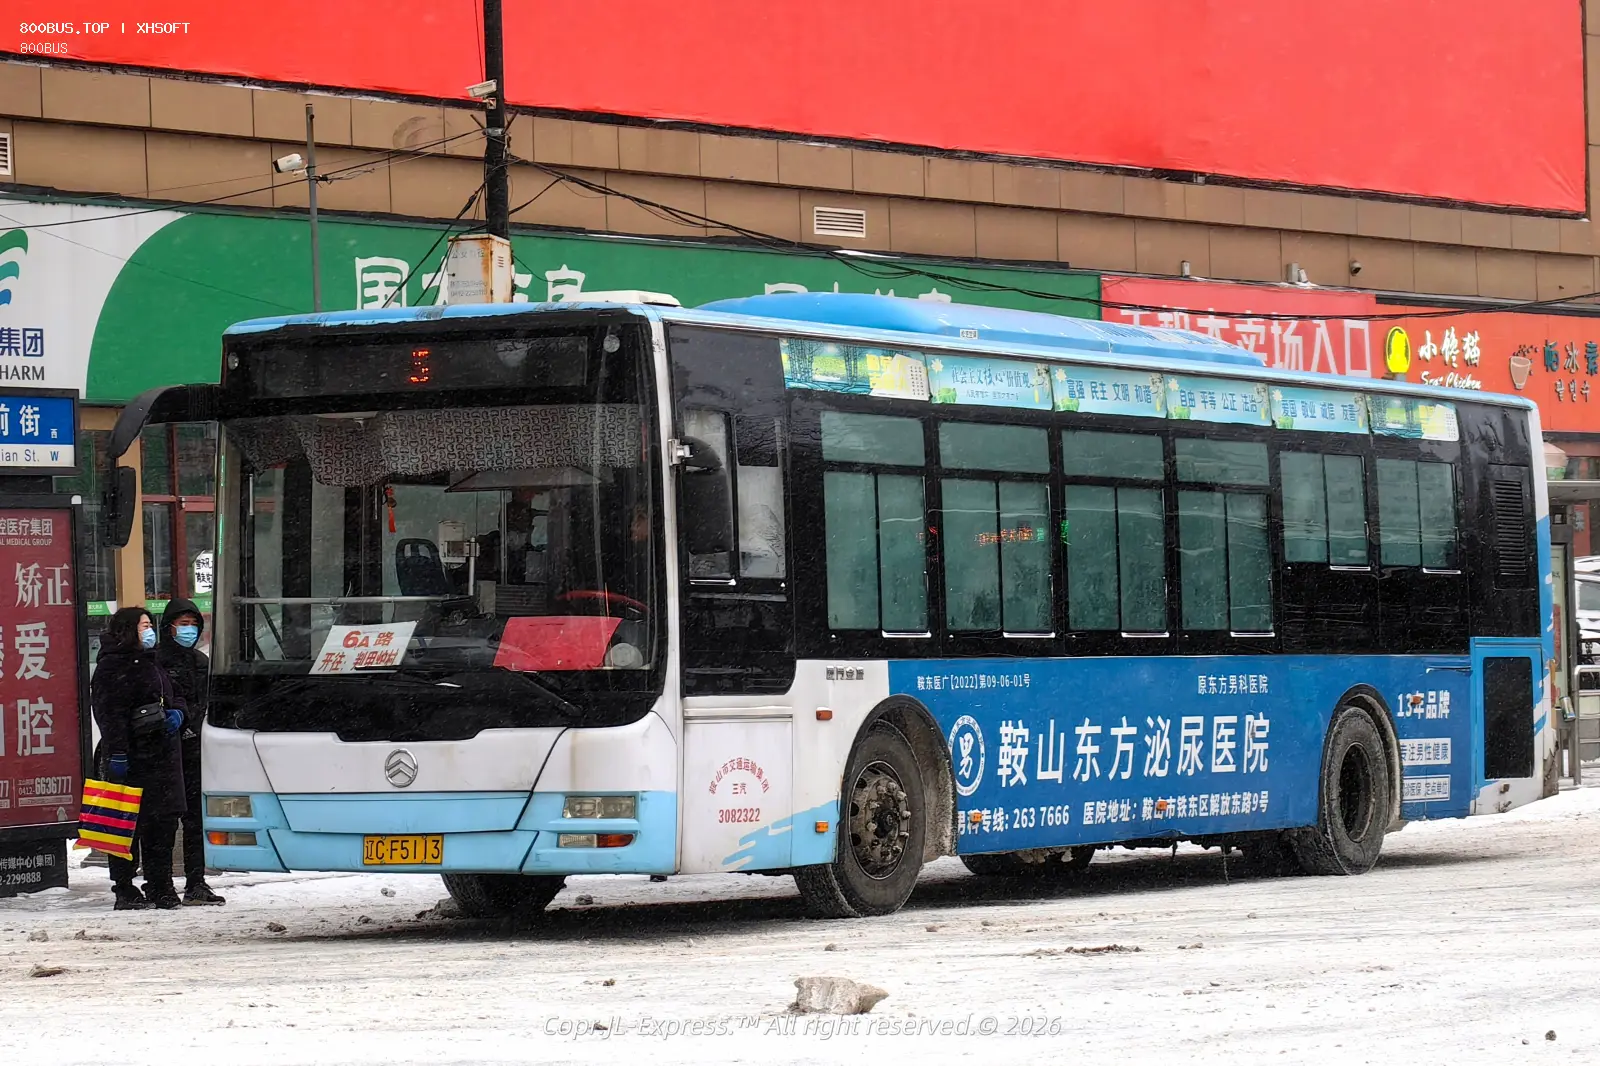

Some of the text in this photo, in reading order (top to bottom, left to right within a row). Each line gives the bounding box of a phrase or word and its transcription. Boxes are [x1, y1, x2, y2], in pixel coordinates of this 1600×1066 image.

[0, 327, 44, 358] 集团
[1066, 379, 1152, 404] 富强 民主 文明 和谐
[1179, 389, 1197, 408] 自由
[1200, 391, 1217, 410] 平等
[1221, 393, 1238, 411] 公正
[1281, 400, 1298, 418] 爱国
[24, 449, 40, 462] St.
[50, 451, 59, 461] W
[6, 537, 32, 546] MEDICAL
[32, 537, 53, 546] GROUP
[15, 562, 73, 609] 矫正
[342, 630, 370, 649] 6A
[0, 621, 51, 681] 爱
[1197, 674, 1269, 695] 原东方男科医院
[1397, 690, 1451, 720] 13年品牌
[0, 696, 55, 757] 腔
[996, 711, 1271, 788] 鞍山东方泌尿医院
[1400, 742, 1449, 761] 专注男性健康
[732, 783, 747, 795] 三汽
[718, 808, 761, 824] 3082322
[1013, 807, 1036, 829] 263
[1040, 804, 1070, 827] 7666
